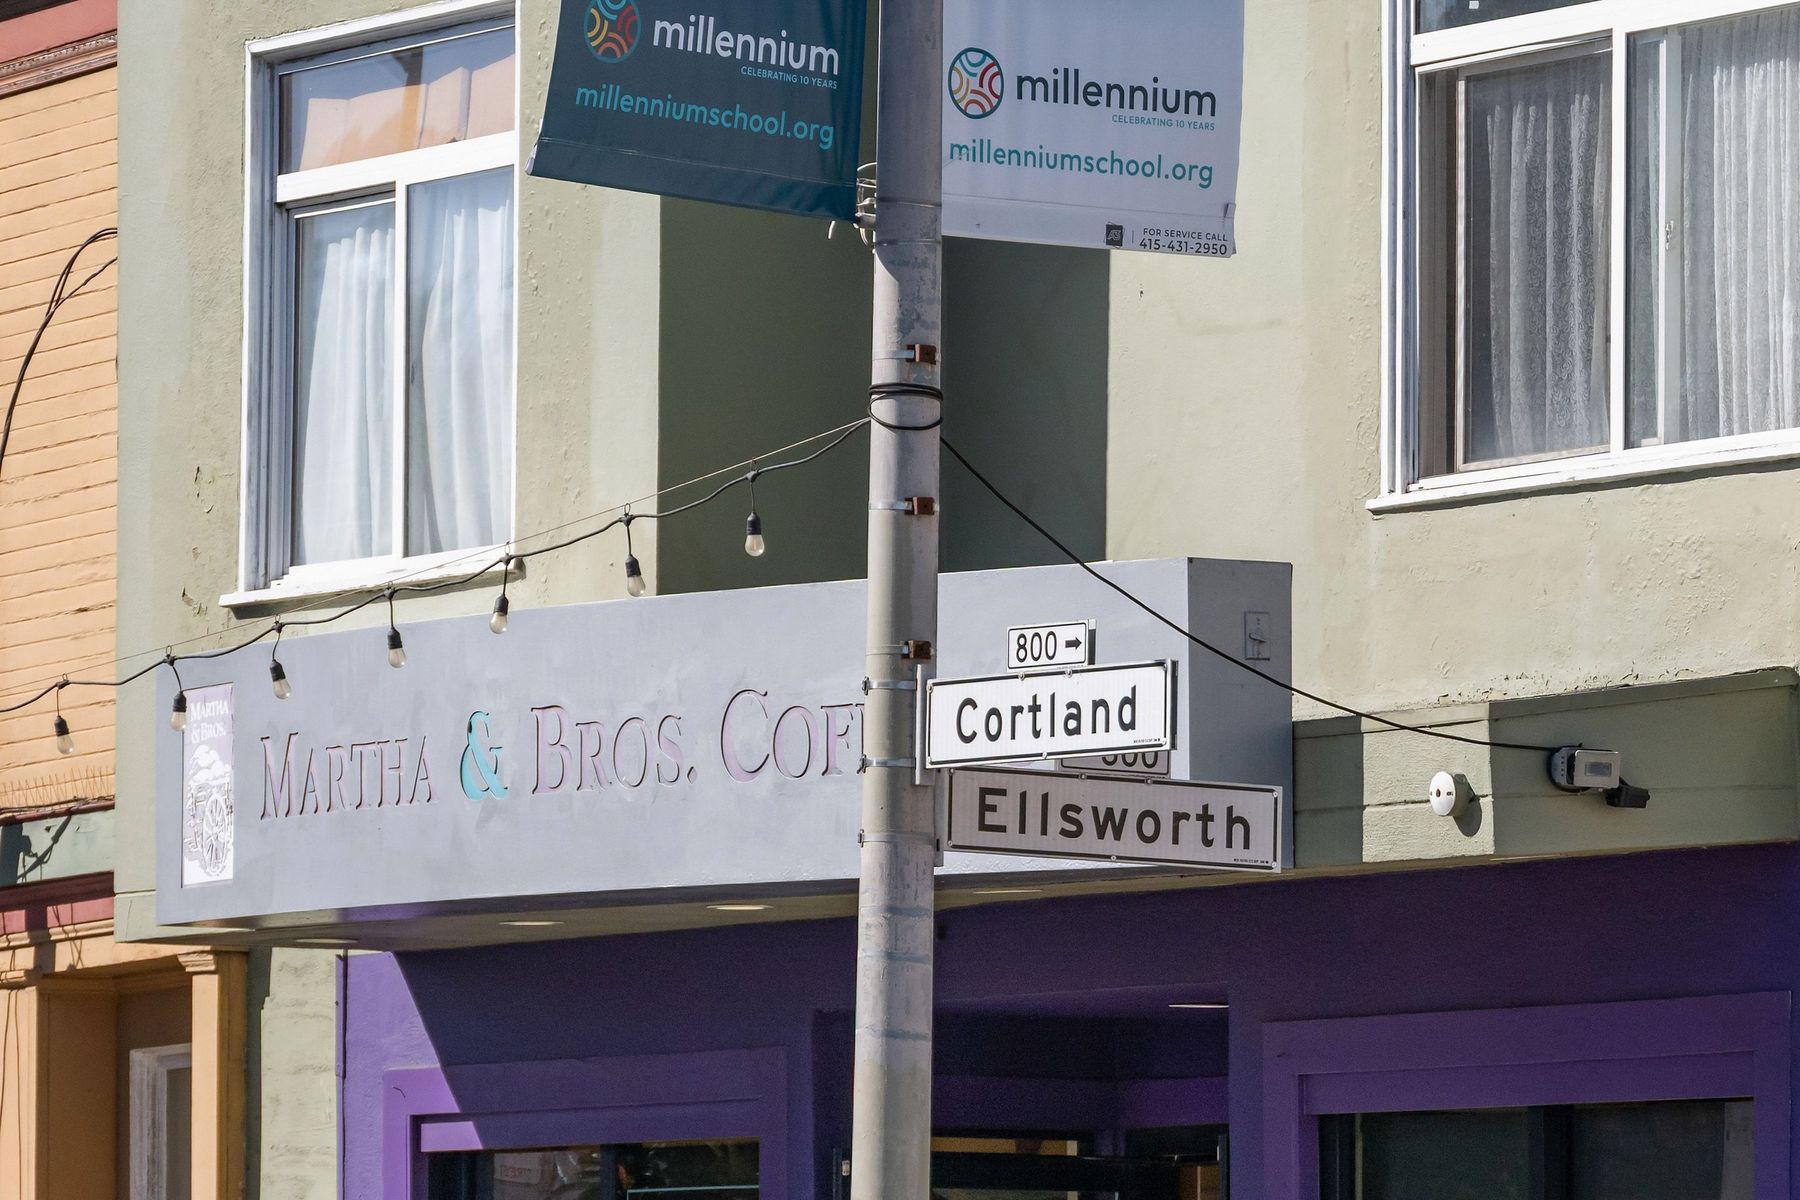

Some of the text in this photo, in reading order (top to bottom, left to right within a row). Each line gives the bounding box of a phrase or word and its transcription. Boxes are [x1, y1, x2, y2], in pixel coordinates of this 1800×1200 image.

[652, 14, 840, 76] millennium
[740, 65, 838, 90] CELEBRATING 10 YEARS
[1015, 66, 1217, 117] millennium
[575, 82, 836, 151] millenniumschool.org
[1111, 113, 1215, 131] CELEBRATING 10 YEARS
[949, 138, 1214, 190] millenniumschool.org
[1139, 237, 1228, 256] 415-431-2950
[1143, 227, 1228, 242] FOR SERVICE CALL
[1016, 630, 1058, 663] 800
[955, 684, 1137, 744] Cortland
[260, 731, 440, 821] MARTHA
[460, 710, 508, 801] &
[531, 703, 696, 795] BROS.
[977, 786, 1251, 850] Ellsworth
